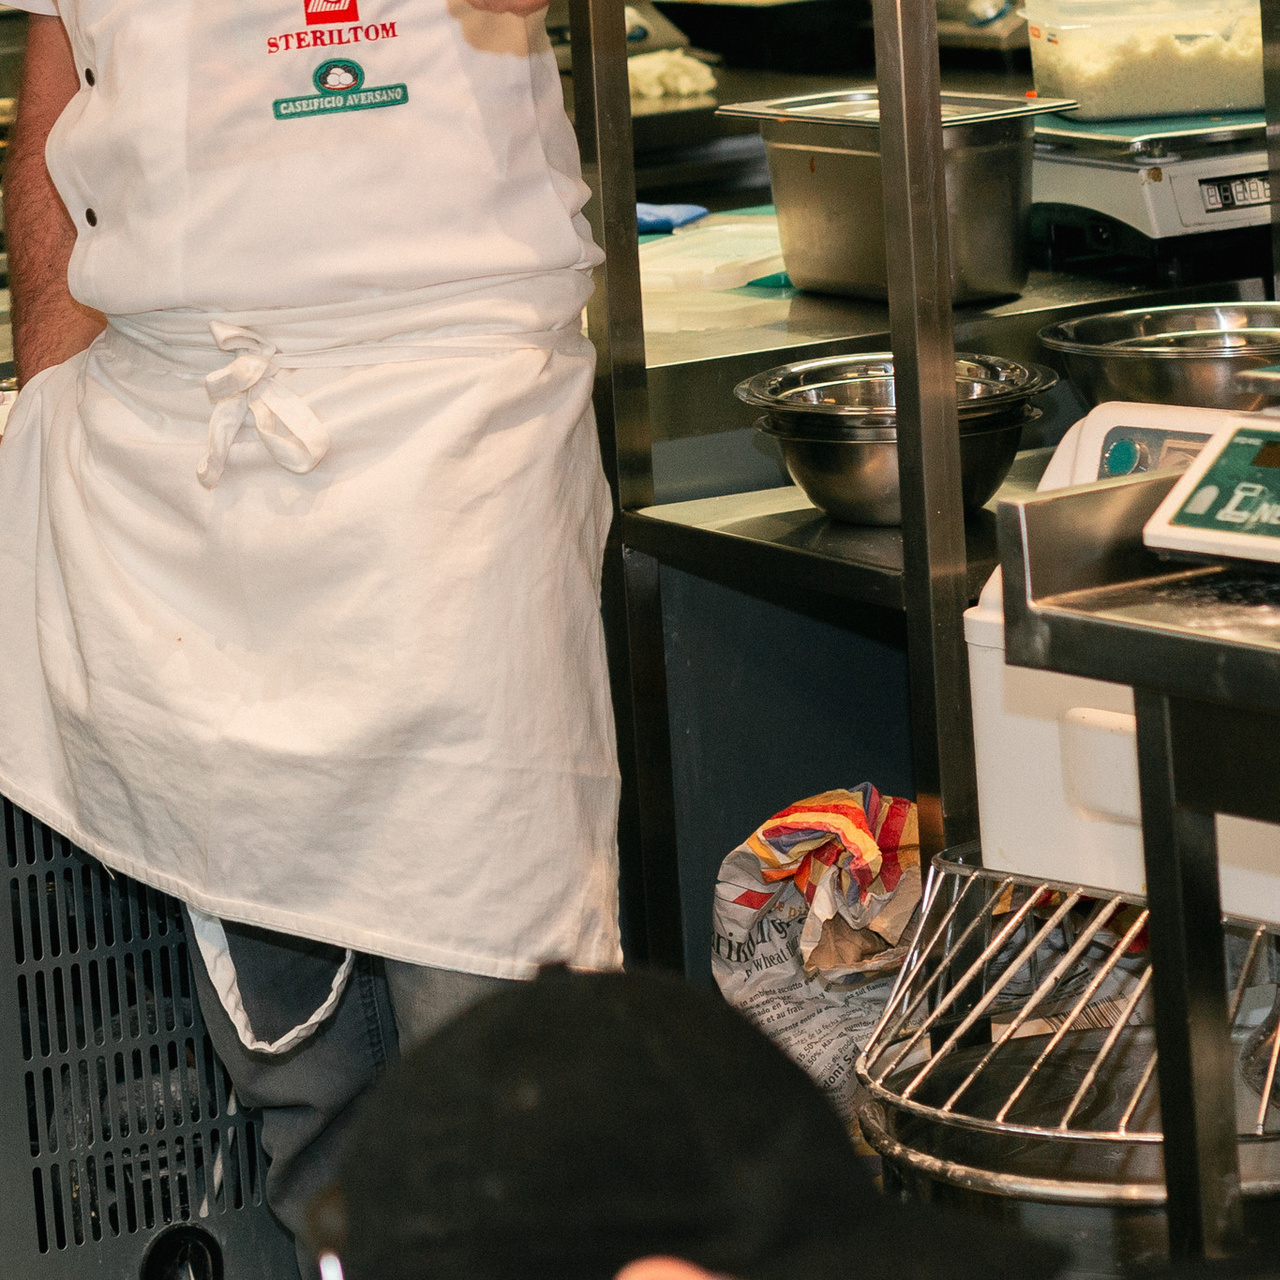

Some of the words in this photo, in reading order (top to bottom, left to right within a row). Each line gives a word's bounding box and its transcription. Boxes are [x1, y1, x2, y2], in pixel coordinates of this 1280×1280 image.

[267, 21, 399, 54] STERILTOM
[280, 96, 344, 115] CASEIFICIO
[346, 88, 403, 106] AVERSANO
[753, 948, 789, 972] wheat
[766, 1015, 775, 1023] et
